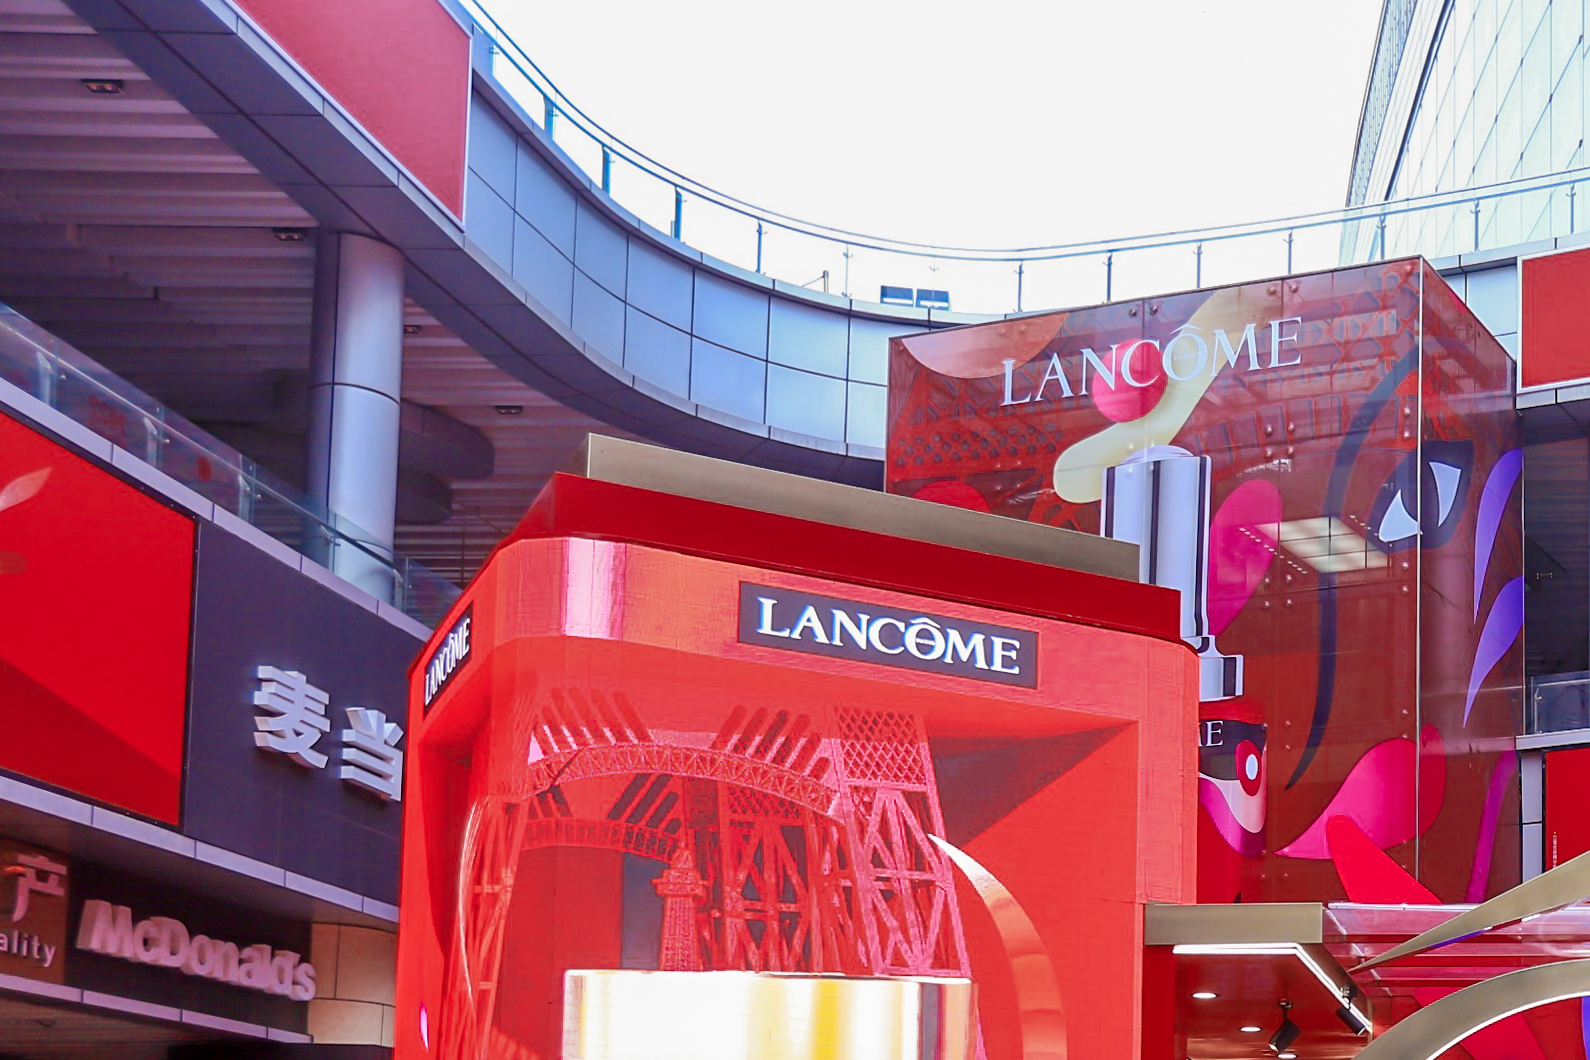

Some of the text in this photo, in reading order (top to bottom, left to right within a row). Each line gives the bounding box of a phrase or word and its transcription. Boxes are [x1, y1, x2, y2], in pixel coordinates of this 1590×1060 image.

[1000, 316, 1303, 407] LANCÔME
[425, 617, 471, 706] LANCÔME
[756, 596, 1021, 675] LANCÔME
[253, 665, 404, 802] 麦当
